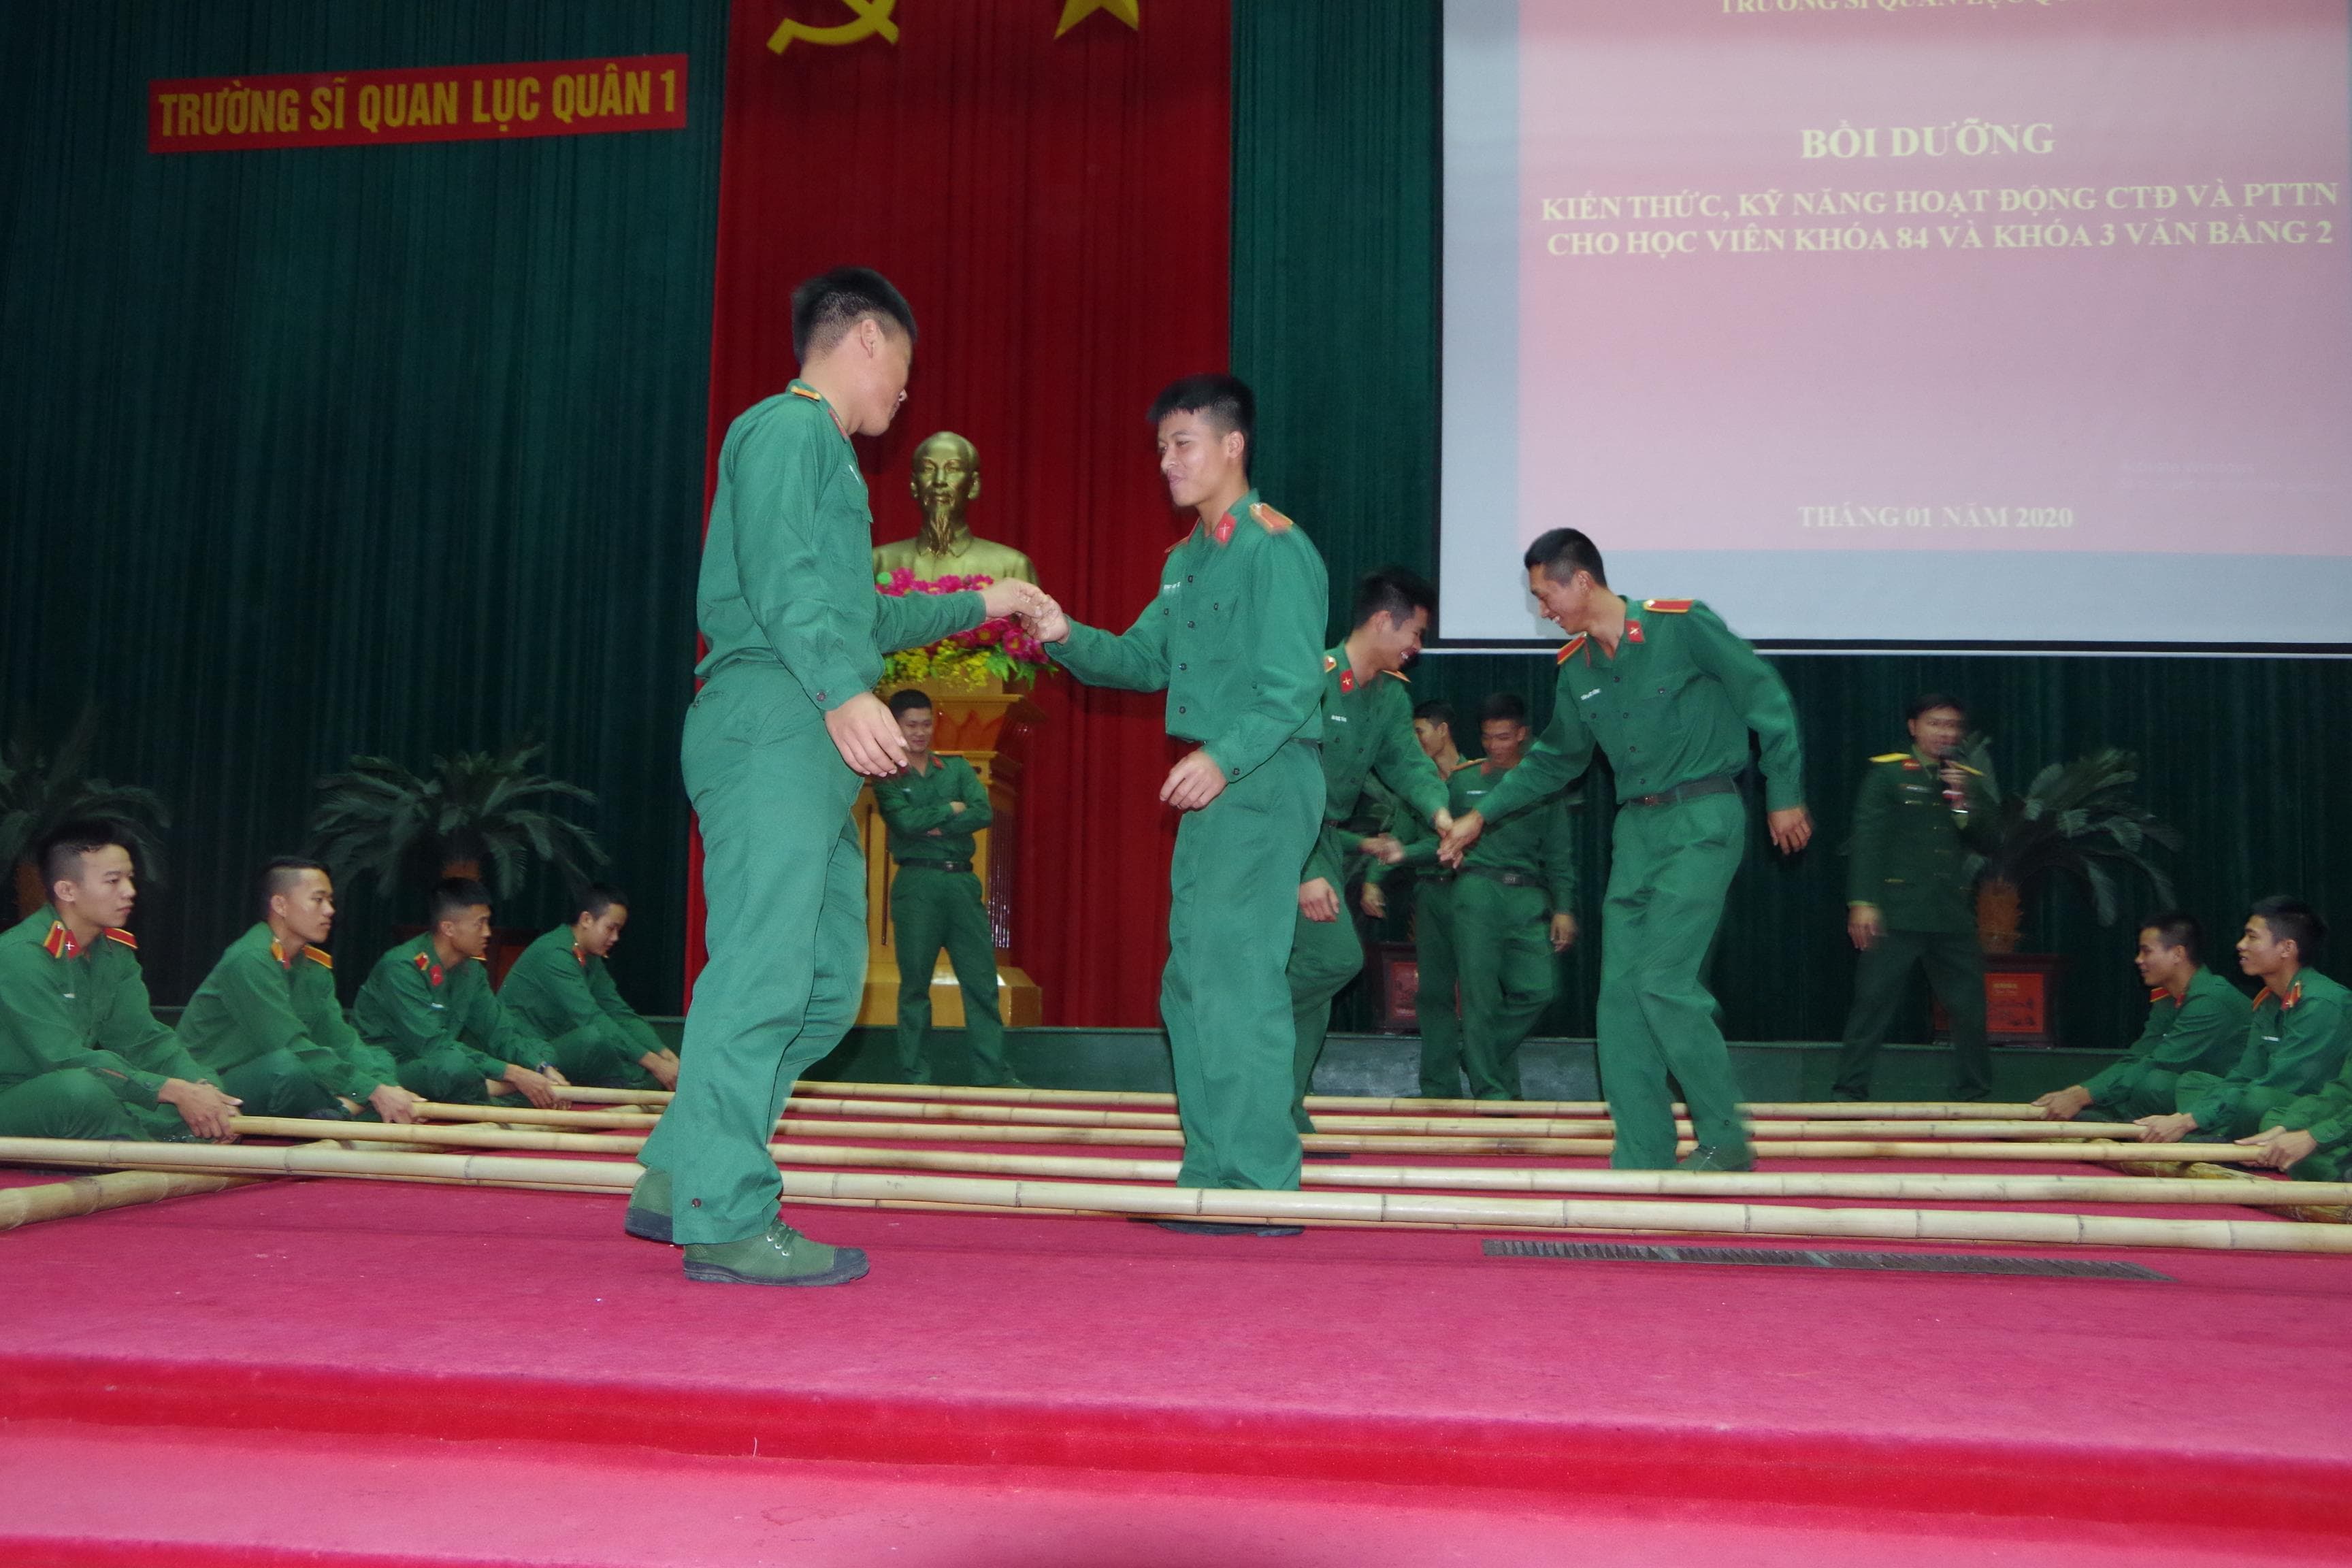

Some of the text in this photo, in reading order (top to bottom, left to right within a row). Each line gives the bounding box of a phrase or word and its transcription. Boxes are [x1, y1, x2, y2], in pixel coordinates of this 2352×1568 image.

[159, 63, 675, 136] TRƯỜNG SĨ QUAN LỤC QUÂN 1
[1889, 118, 2056, 157] DƯỠNG
[1541, 178, 2339, 222] KIẾN THỨC, KỸ NĂNG HOẠT ĐỘNG CTĐ VÀ PTTN
[1547, 213, 2333, 259] CHO HỌC VIÊN KHÓA 84 VÀ KHÓA 3 VĂN BẰNG 2
[1798, 502, 2074, 527] THÁNG 01 NĂM 2020
